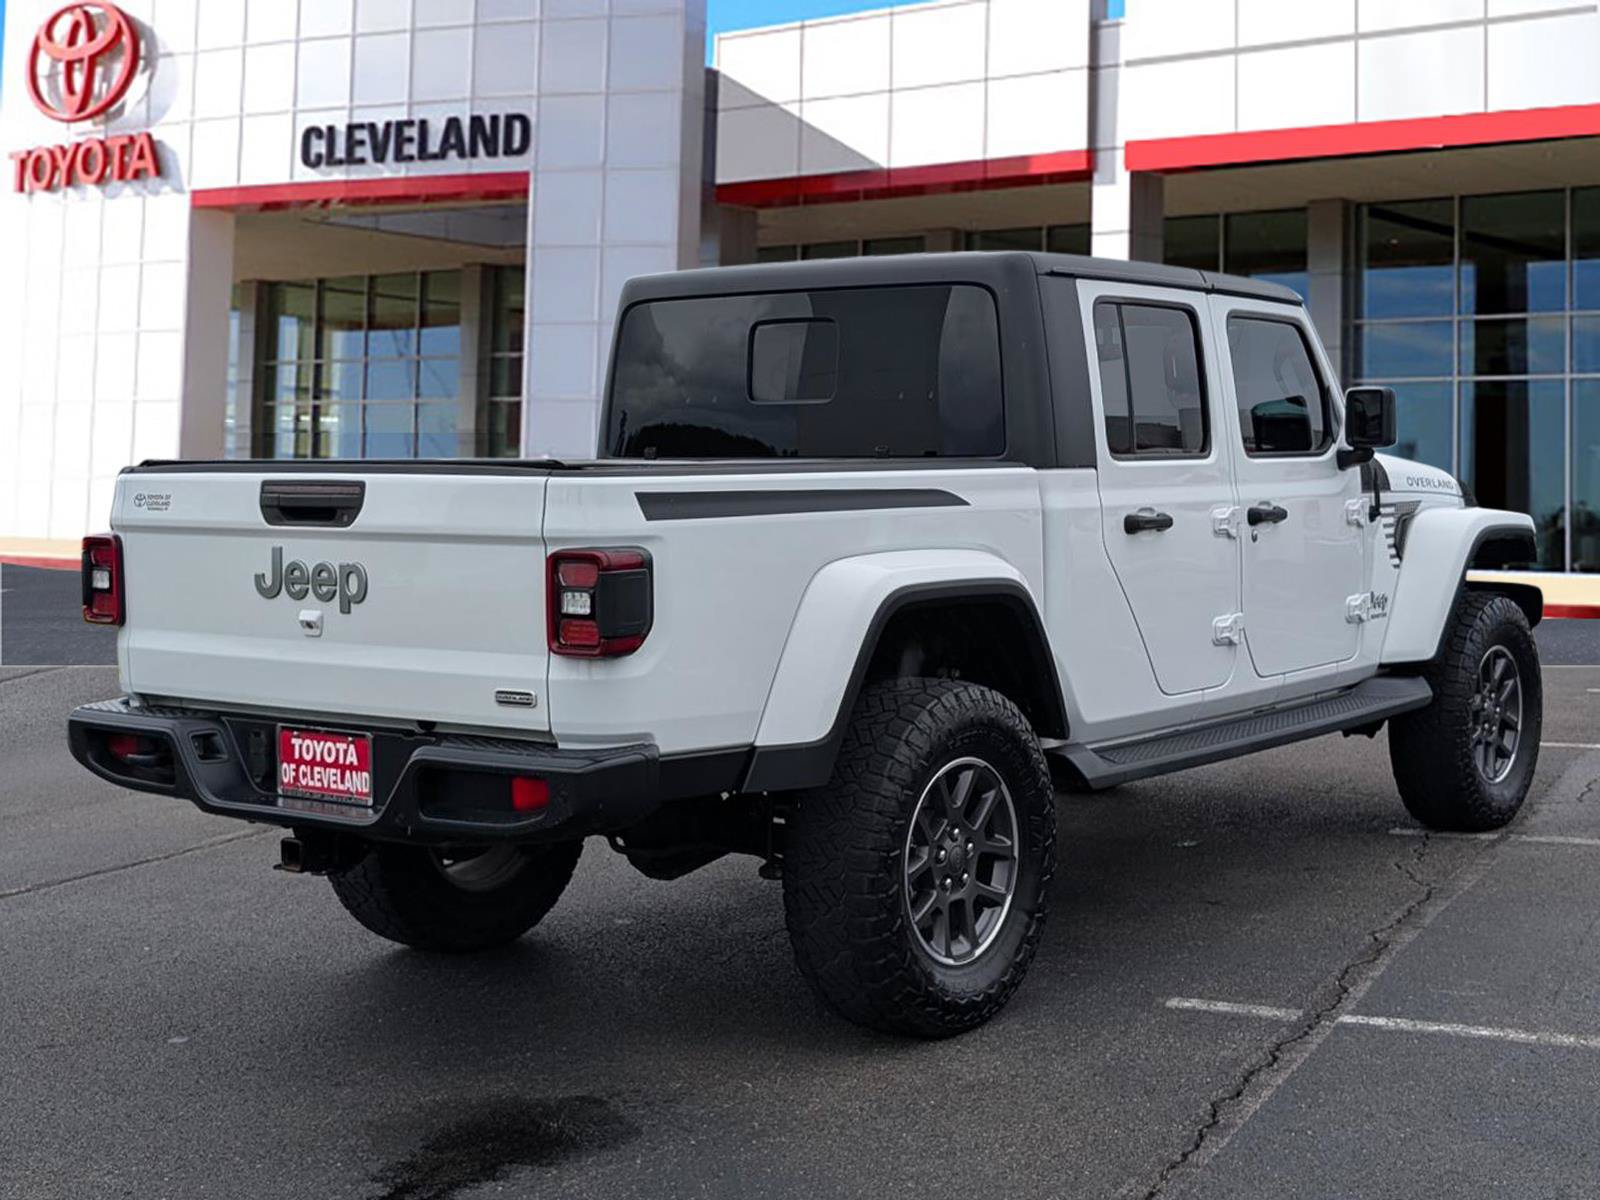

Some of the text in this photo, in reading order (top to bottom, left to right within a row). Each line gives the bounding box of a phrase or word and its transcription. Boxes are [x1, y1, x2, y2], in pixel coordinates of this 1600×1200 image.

[9, 131, 162, 193] TOYOTA
[301, 113, 531, 169] CLEVELAND
[254, 546, 368, 614] Jeep
[281, 762, 370, 793] OF CLEVELAND
[291, 737, 359, 766] TOYOTA
